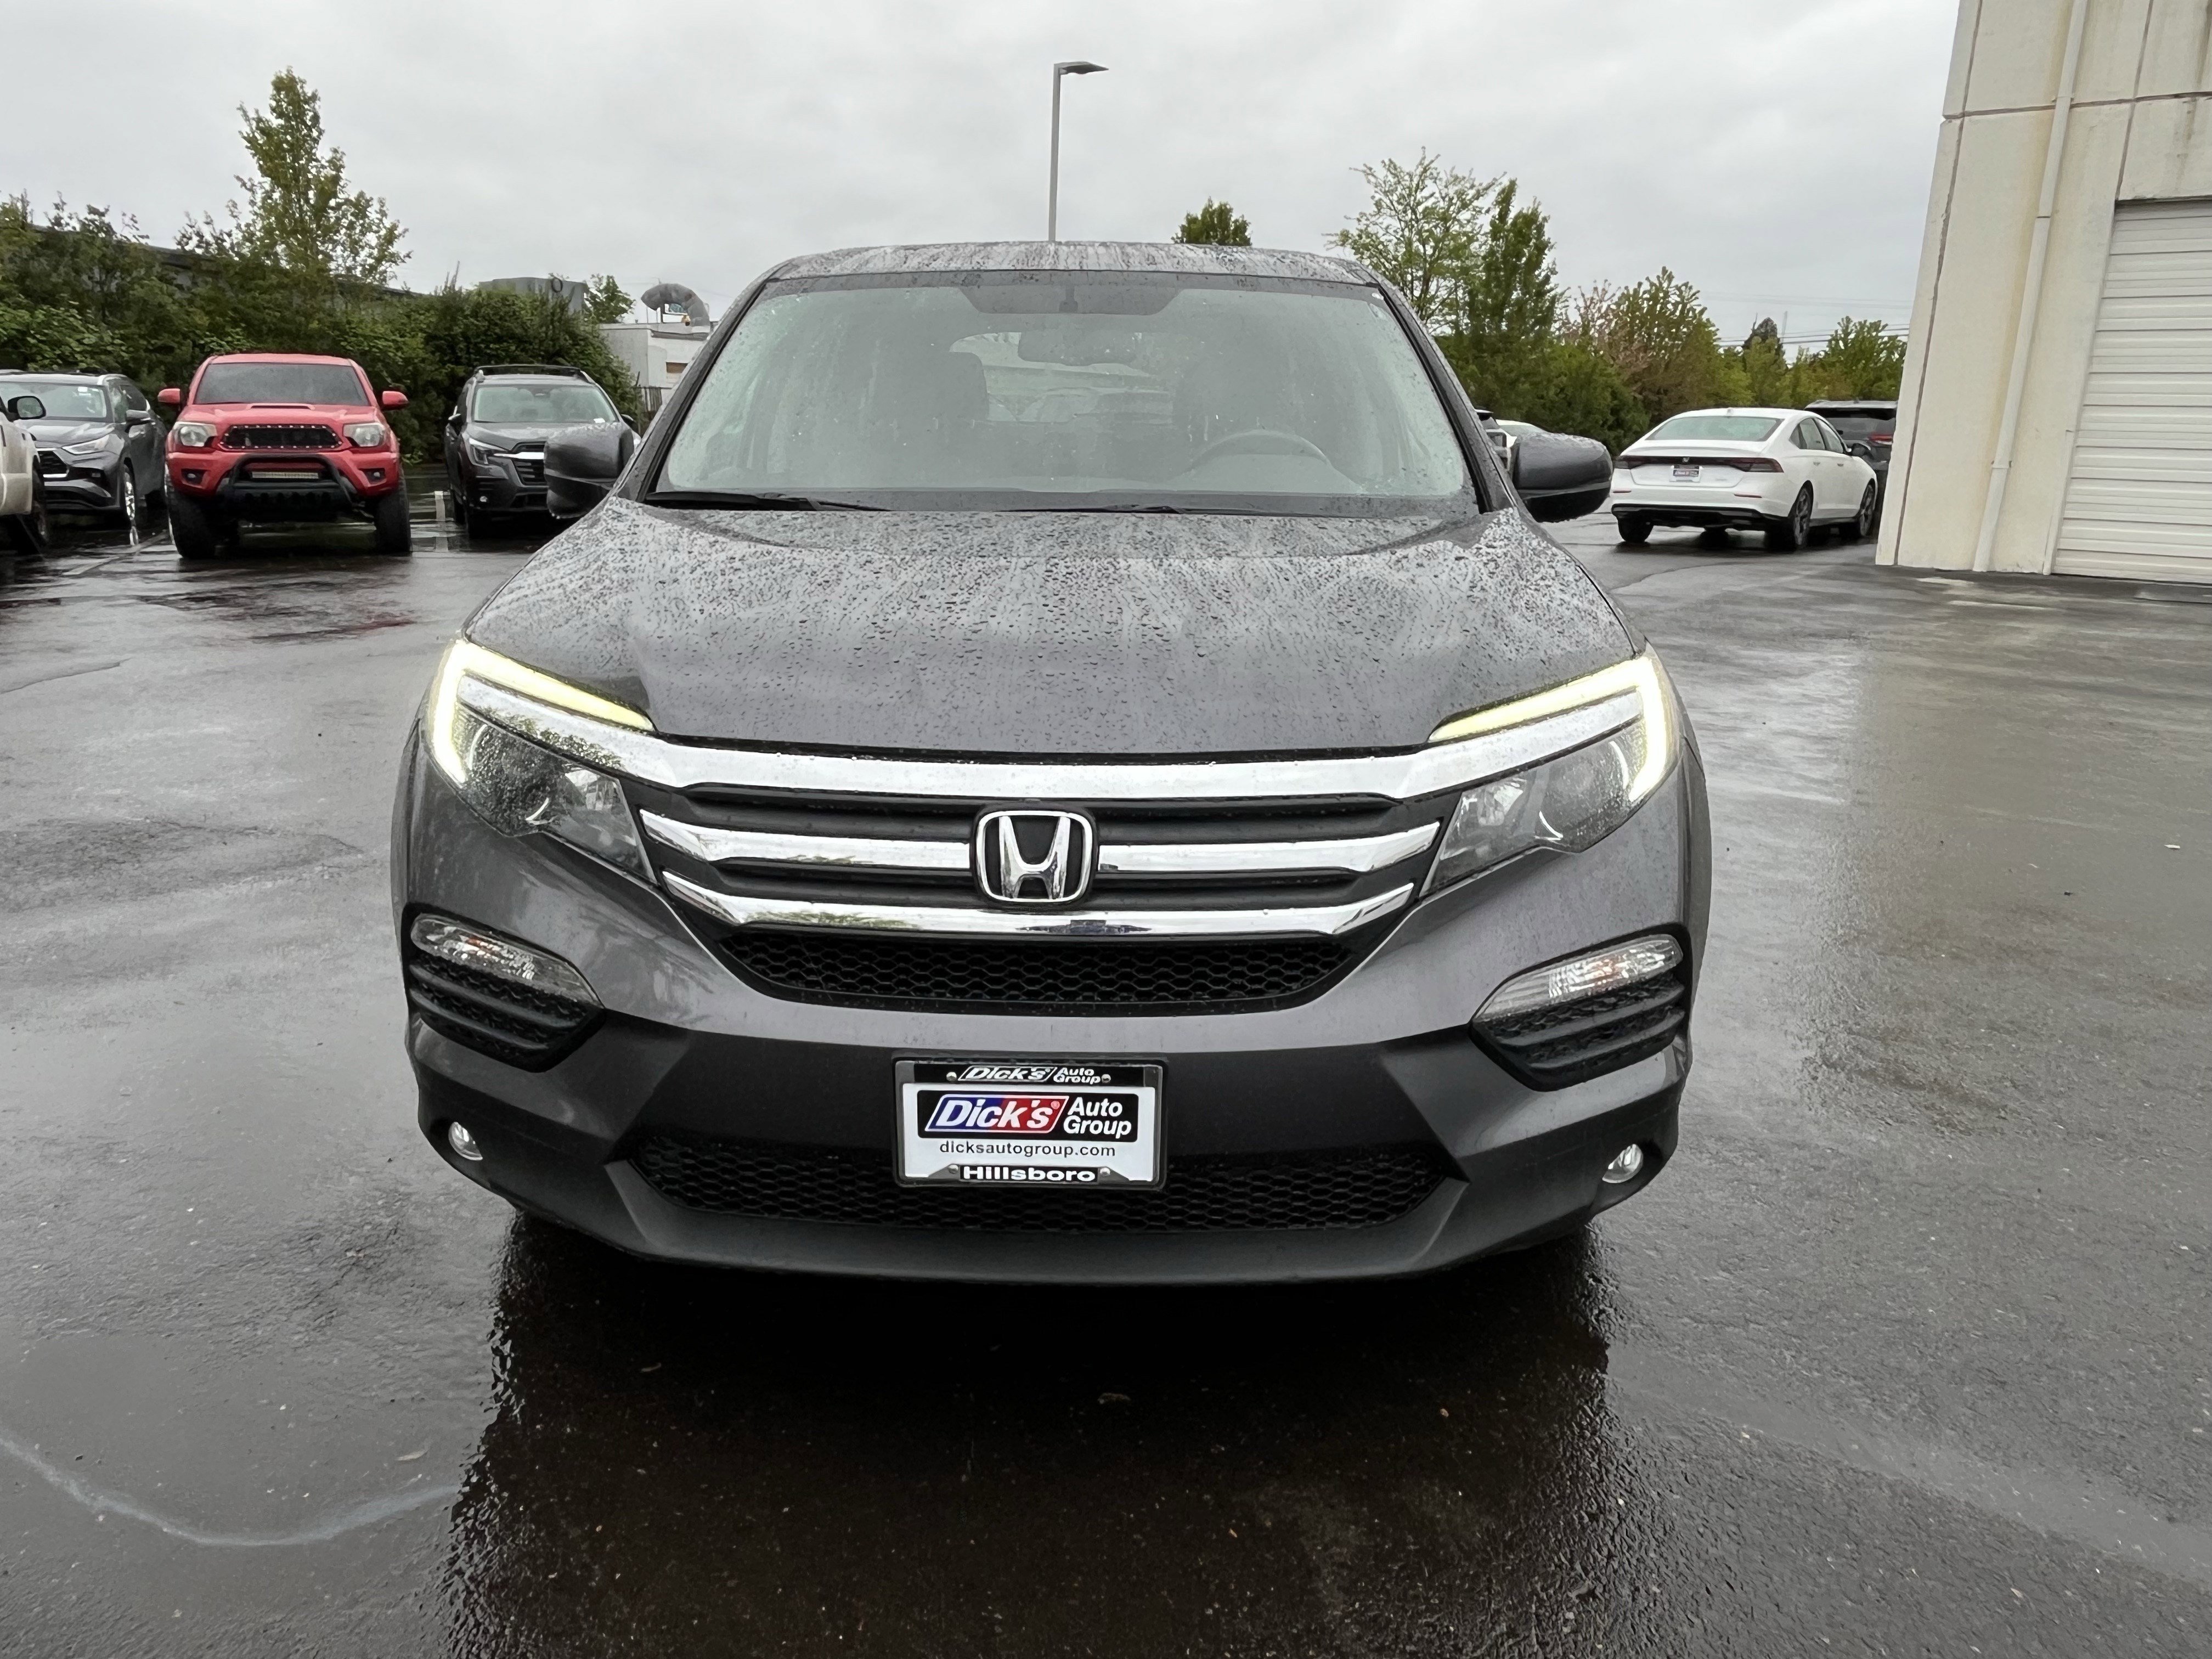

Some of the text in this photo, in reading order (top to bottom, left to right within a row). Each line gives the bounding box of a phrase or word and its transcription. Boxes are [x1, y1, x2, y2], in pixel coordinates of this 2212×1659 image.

[1053, 1074, 1101, 1085] Group
[1059, 1067, 1094, 1076] Auto
[935, 1097, 1123, 1128] Dick's Auto
[1063, 1115, 1132, 1139] Group
[939, 1141, 1116, 1158] dicksautogroup.com
[963, 1166, 1096, 1182] Hillsboro
